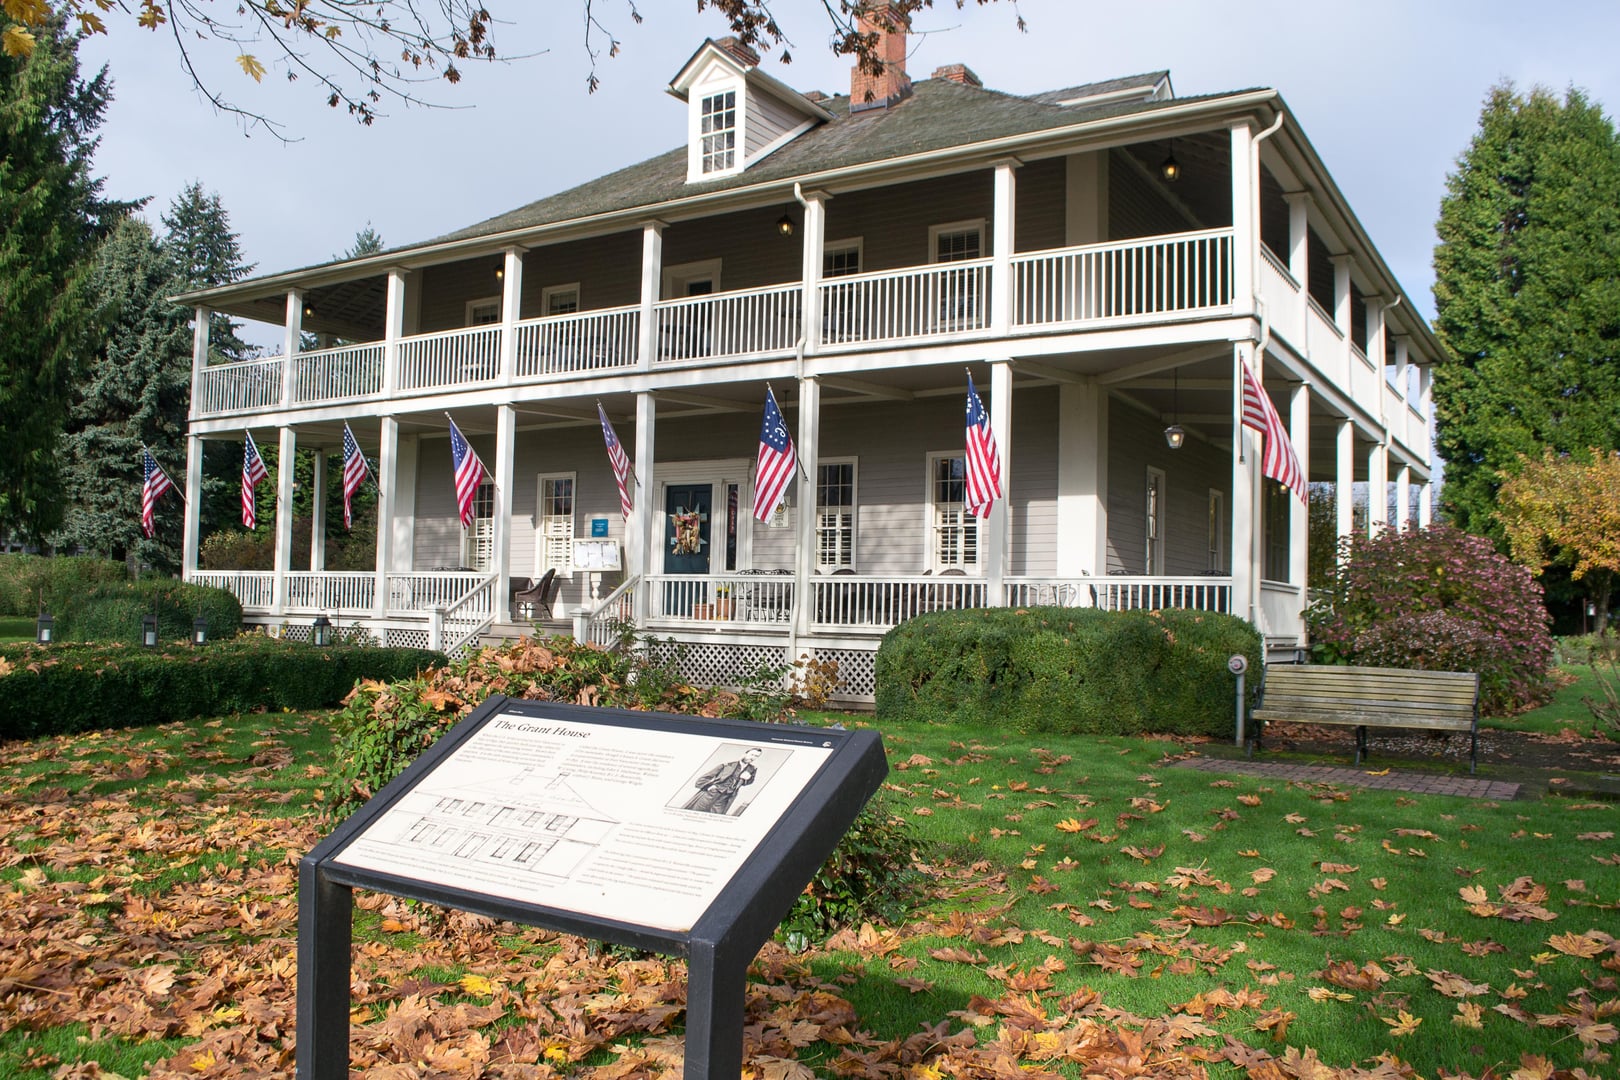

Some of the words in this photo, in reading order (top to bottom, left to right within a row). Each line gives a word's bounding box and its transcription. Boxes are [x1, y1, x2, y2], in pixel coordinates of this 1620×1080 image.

[494, 720, 516, 730] The
[517, 723, 552, 734] Grant
[552, 726, 591, 738] House
